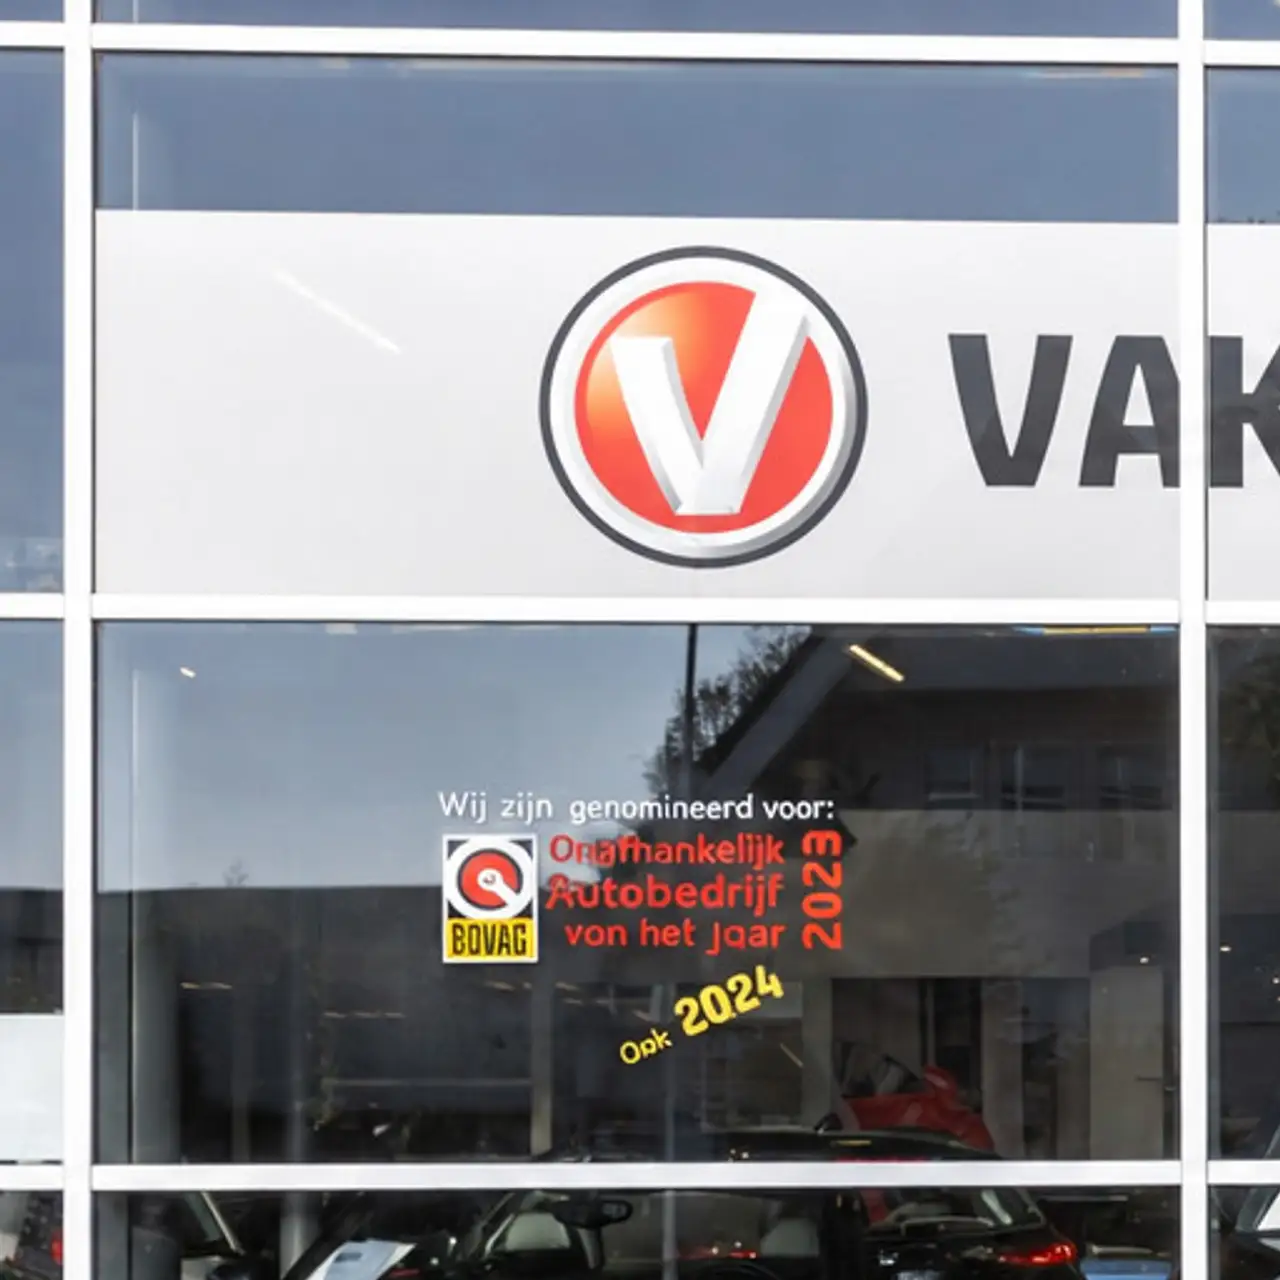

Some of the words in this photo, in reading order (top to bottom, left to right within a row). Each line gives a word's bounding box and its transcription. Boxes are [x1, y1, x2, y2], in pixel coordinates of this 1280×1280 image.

[438, 791, 487, 824] Wij
[501, 791, 553, 826] zijn
[569, 793, 754, 825] genomineerd
[762, 800, 835, 820] voor:
[545, 871, 785, 918] Autobedrijf
[802, 829, 843, 950] 2023
[451, 922, 528, 957] BOVAG
[639, 917, 696, 948] het
[674, 964, 785, 1037] 2024
